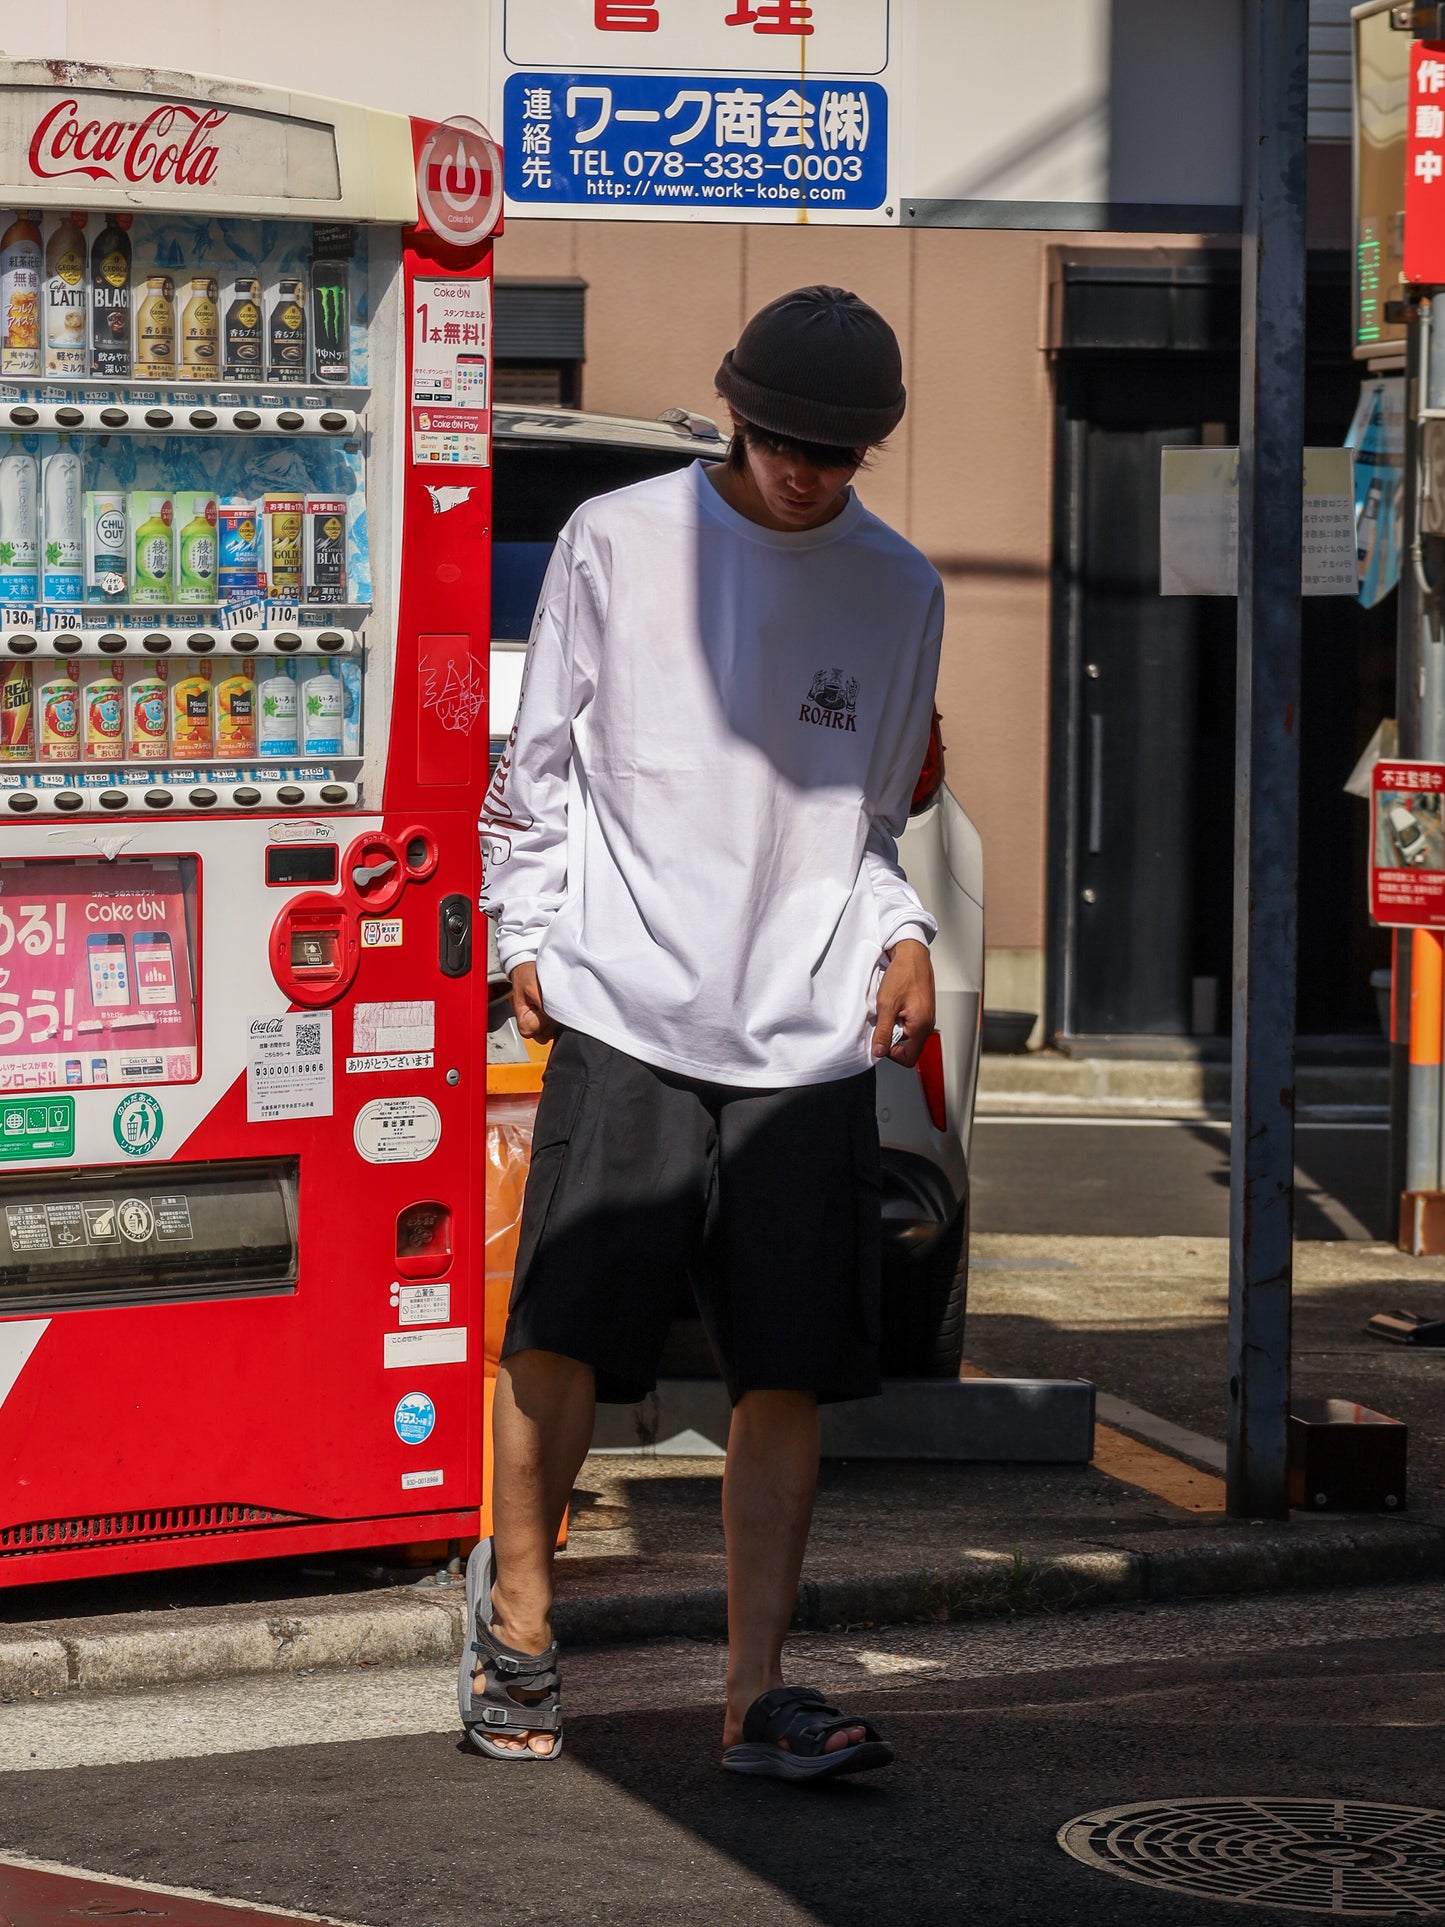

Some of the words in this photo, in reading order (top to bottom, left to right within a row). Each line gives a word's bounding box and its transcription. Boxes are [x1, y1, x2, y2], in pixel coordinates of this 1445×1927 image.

[1415, 59, 1445, 184] 作動中
[28, 98, 231, 187] Coca-Cola
[521, 87, 552, 190] 連絡先
[568, 148, 614, 177] TEL
[623, 149, 863, 182] 078-333-0003
[586, 179, 846, 201] http://www.work-kobe.com
[433, 287, 456, 298] Coke
[456, 287, 471, 299] ON
[443, 309, 486, 319] スタンプたまると
[416, 302, 486, 347] 1本無料!
[432, 419, 451, 428] Coke
[464, 421, 479, 432] Pay
[101, 519, 125, 530] CHILL
[104, 530, 124, 540] OUT
[6, 609, 34, 626] 130円
[54, 614, 82, 630] 130円
[231, 607, 259, 626] 110円
[271, 606, 297, 622] 110円
[57, 720, 75, 731] Qoo
[101, 720, 119, 731] Qoo
[146, 719, 164, 730] Qoo
[798, 703, 858, 733] ROARK
[1381, 769, 1443, 789] 不正監視中
[315, 828, 330, 838] Pay
[85, 901, 134, 922] Coke
[136, 897, 166, 921] ON
[384, 933, 397, 943] OK
[348, 1054, 432, 1072] ありがとうございます
[117, 1093, 160, 1116] のんだあとは
[120, 1136, 159, 1155] リサイクル
